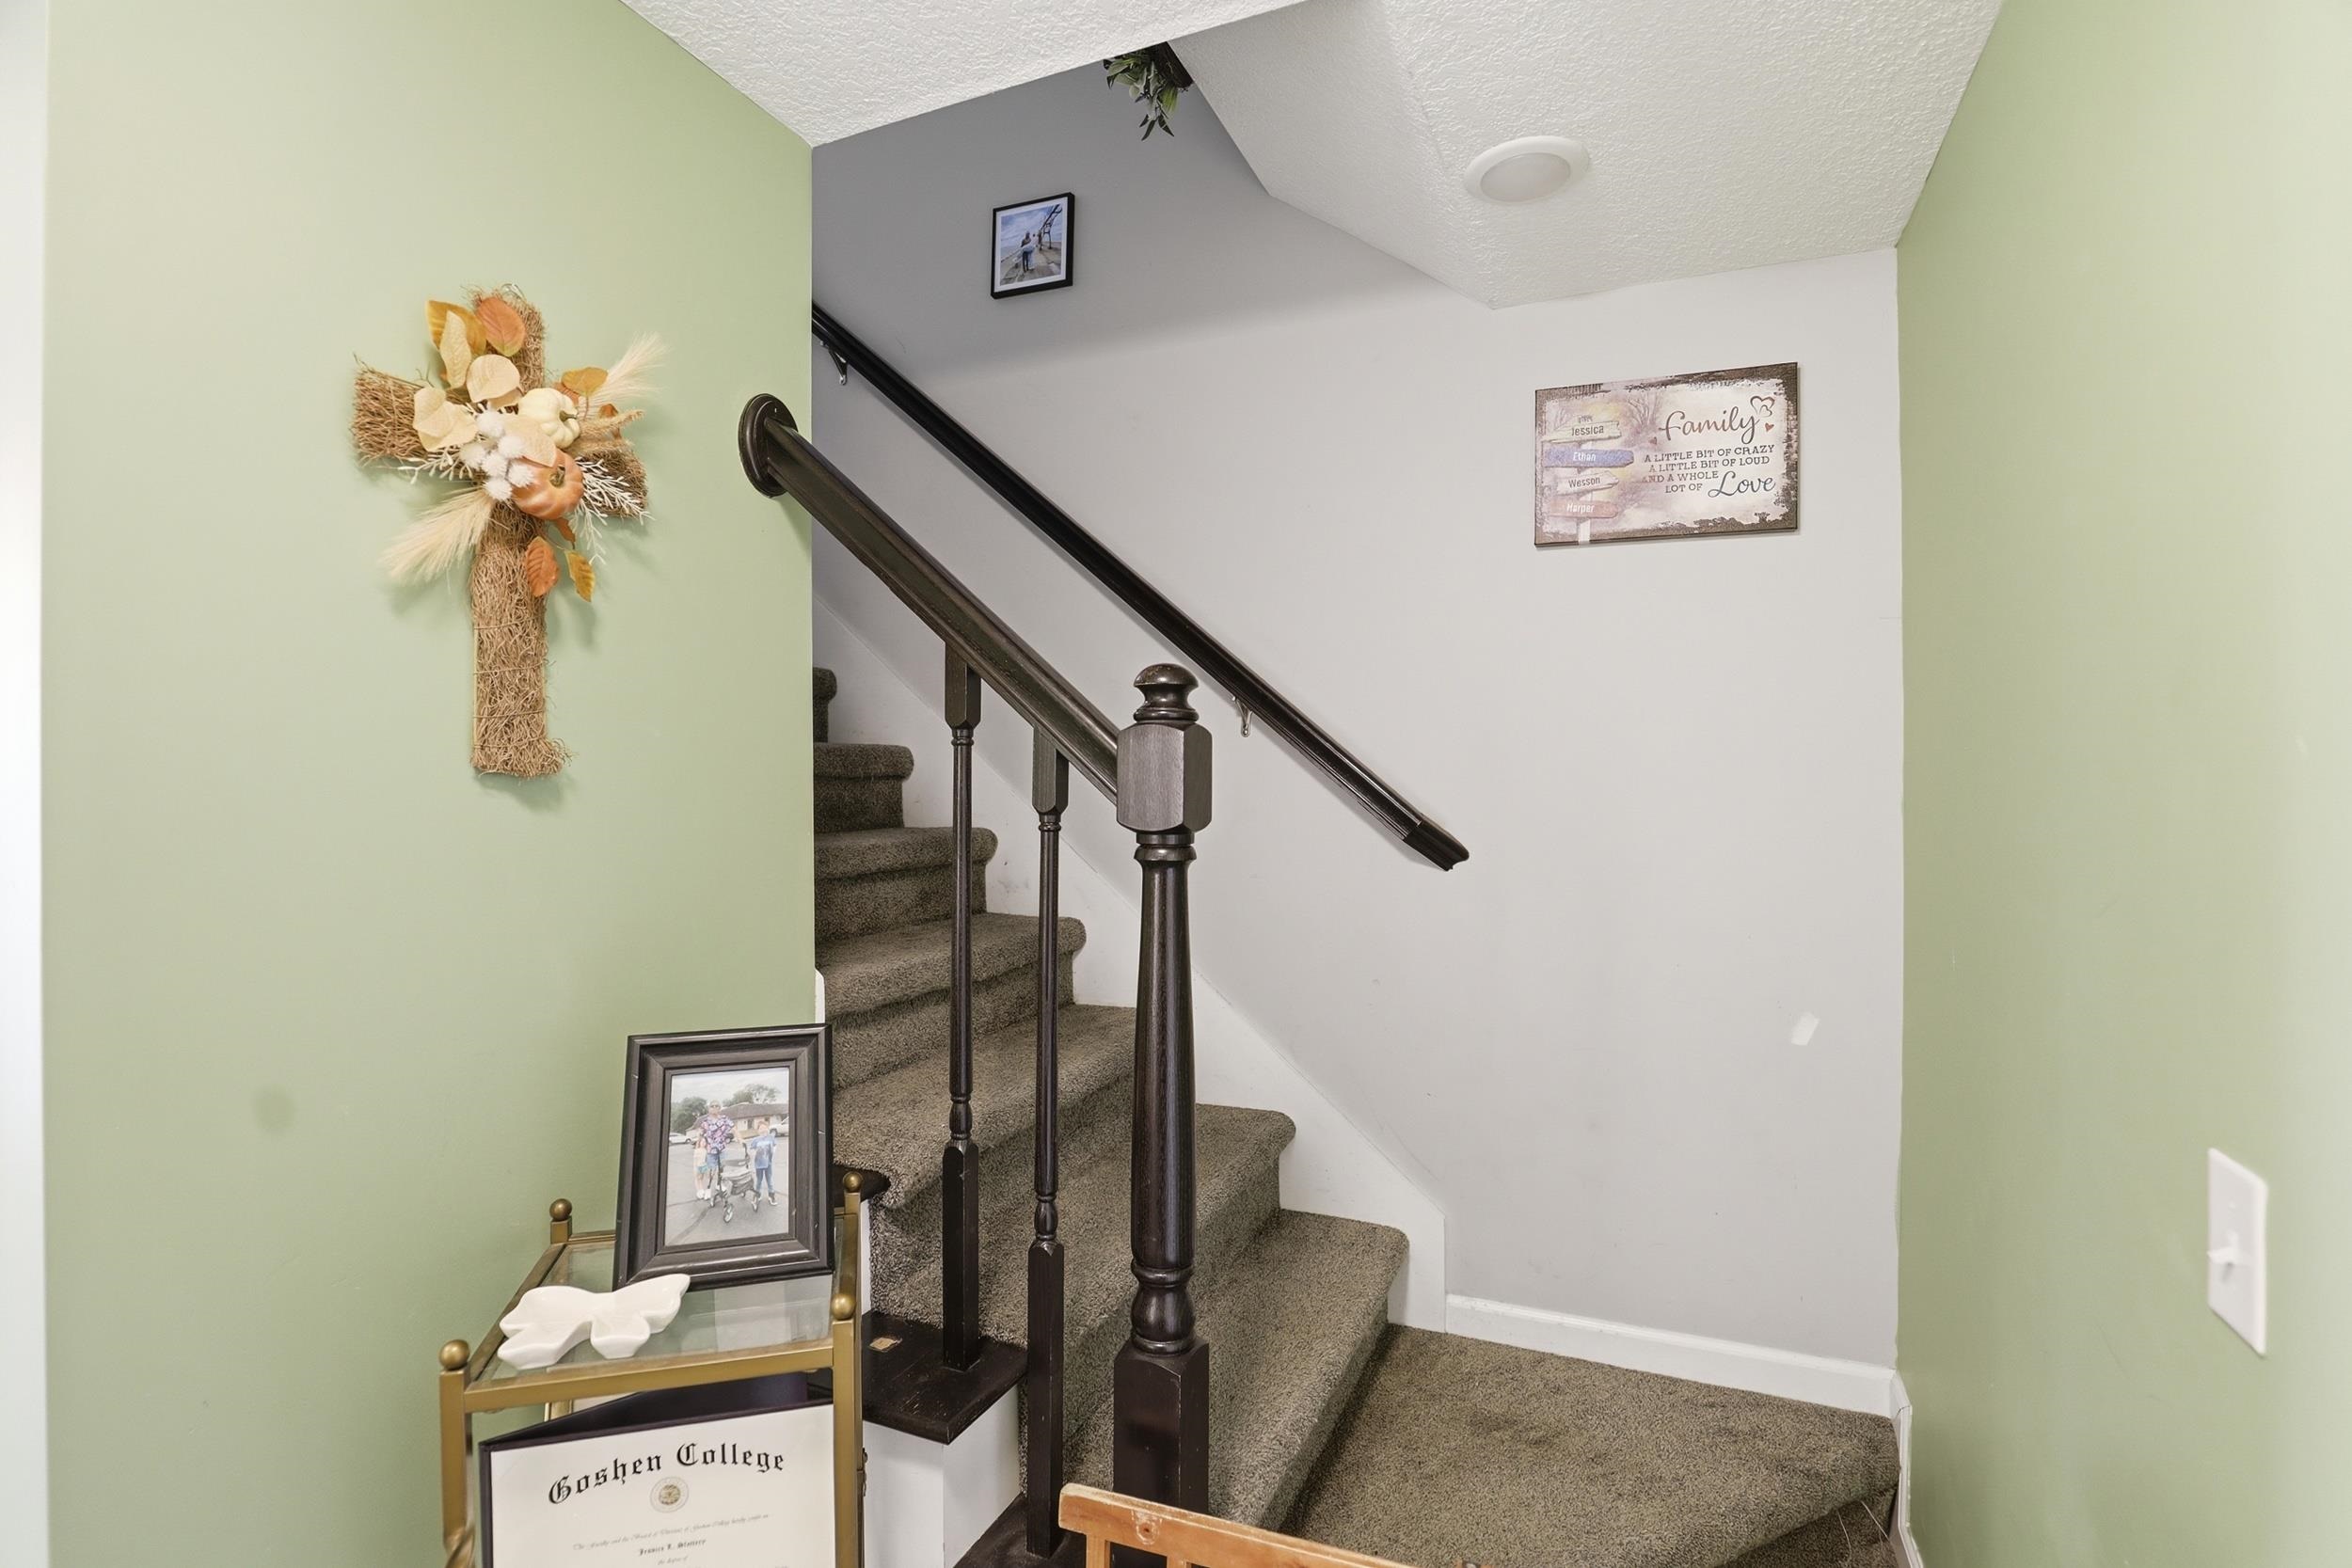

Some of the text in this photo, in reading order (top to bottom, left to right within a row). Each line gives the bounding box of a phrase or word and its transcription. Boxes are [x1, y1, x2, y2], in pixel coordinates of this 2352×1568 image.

[1571, 425, 1604, 436] Jessica
[1572, 451, 1597, 462] Ethan
[1655, 451, 1693, 462] LITTLE
[1696, 450, 1714, 458] BIT
[1718, 448, 1732, 457] OF
[1734, 445, 1775, 455] CRAZY
[1659, 461, 1697, 472] LITTLE
[1700, 459, 1720, 468] BIT
[1722, 458, 1737, 467] OF
[1739, 456, 1771, 466] LOUD
[1568, 476, 1600, 488] Wesson
[1641, 471, 1719, 483] AND A WHOLE
[1665, 470, 1776, 498] LOT OF Love
[1566, 503, 1596, 515] Harper
[548, 1442, 785, 1506] Goshen College
